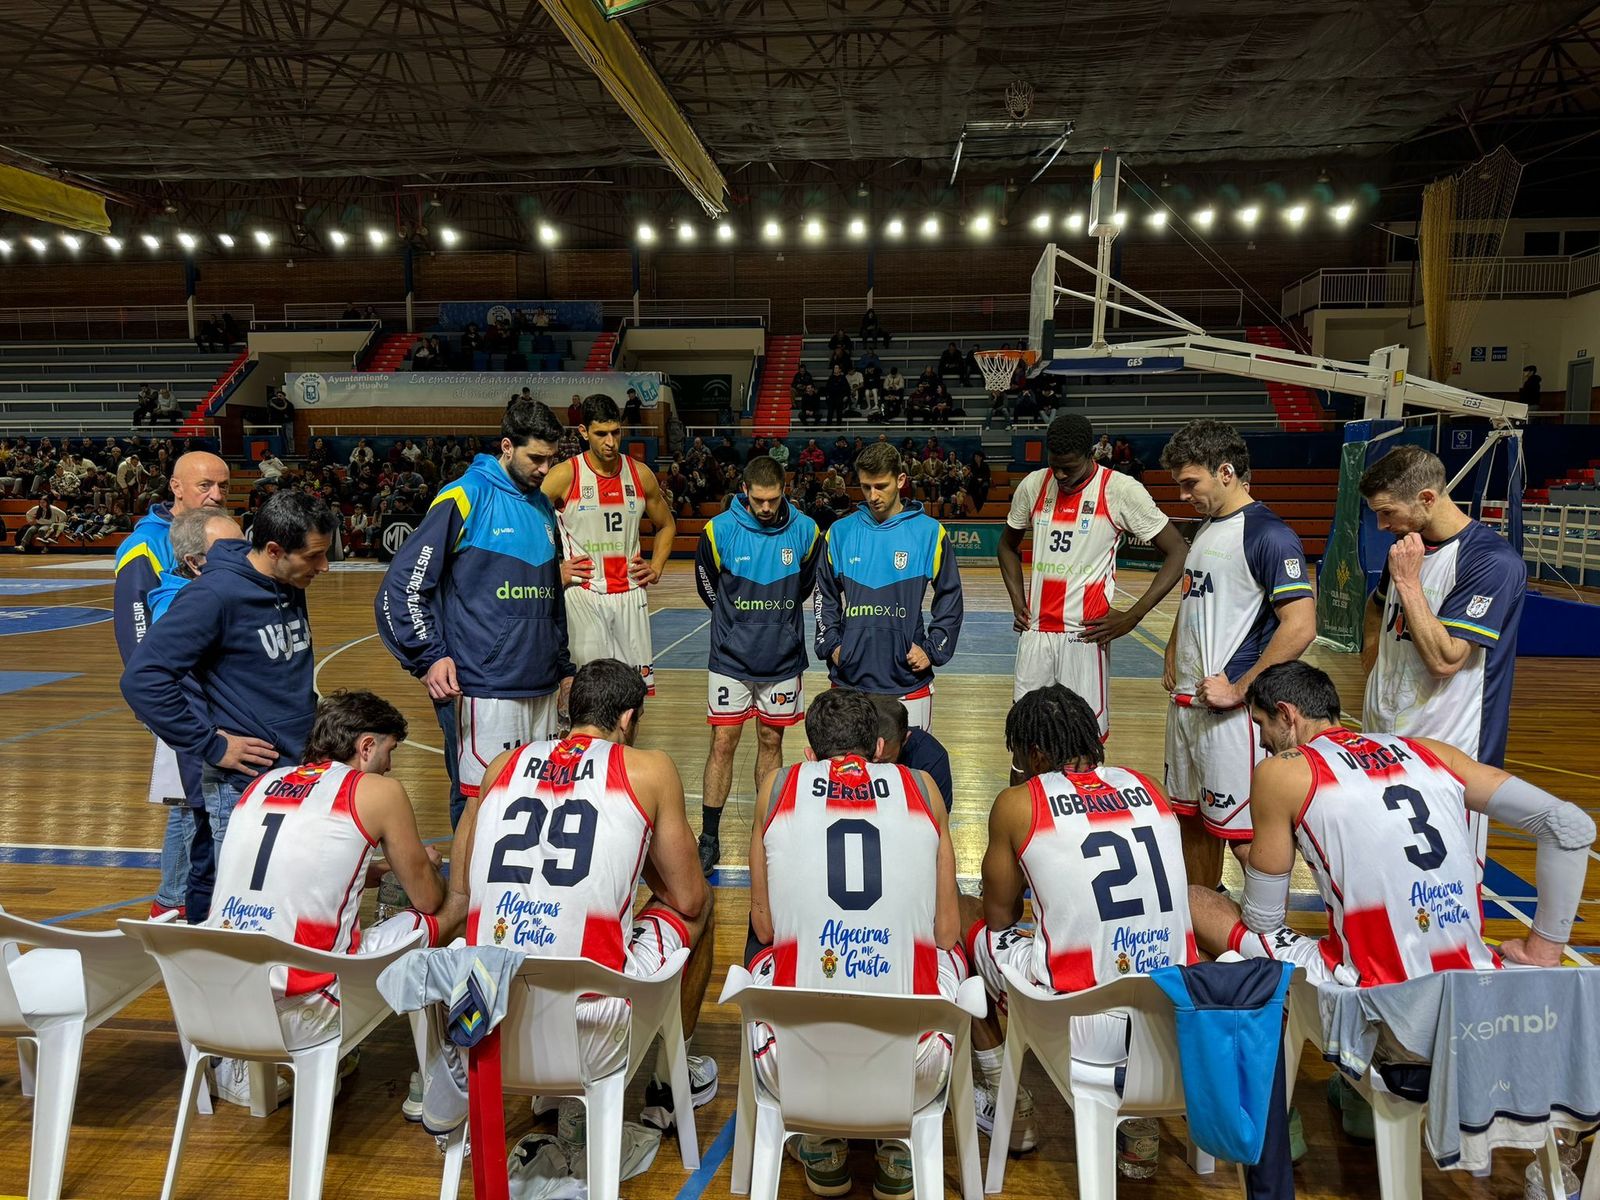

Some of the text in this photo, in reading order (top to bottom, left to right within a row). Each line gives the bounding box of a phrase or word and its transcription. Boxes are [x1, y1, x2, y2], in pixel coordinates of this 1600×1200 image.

[1127, 357, 1143, 367] GES
[328, 374, 389, 384] Ayuntamiento
[603, 511, 623, 532] 12
[1049, 529, 1074, 552] 35
[717, 686, 730, 706] 2
[812, 777, 890, 800] SERGIO
[1049, 786, 1153, 817] IGBANUGO
[487, 796, 599, 887] 29
[1382, 783, 1448, 872] 3
[249, 812, 286, 891] 1
[827, 818, 882, 911] 0
[1080, 825, 1173, 922] 21
[222, 895, 276, 925] Algeciras
[496, 890, 563, 927] Algeciras
[1408, 880, 1464, 912] Algeciras
[513, 919, 557, 947] Gusta
[818, 919, 892, 956] Algeciras
[1111, 926, 1171, 956] Algeciras
[845, 950, 892, 979] Gusta
[1135, 948, 1169, 974] Gusta
